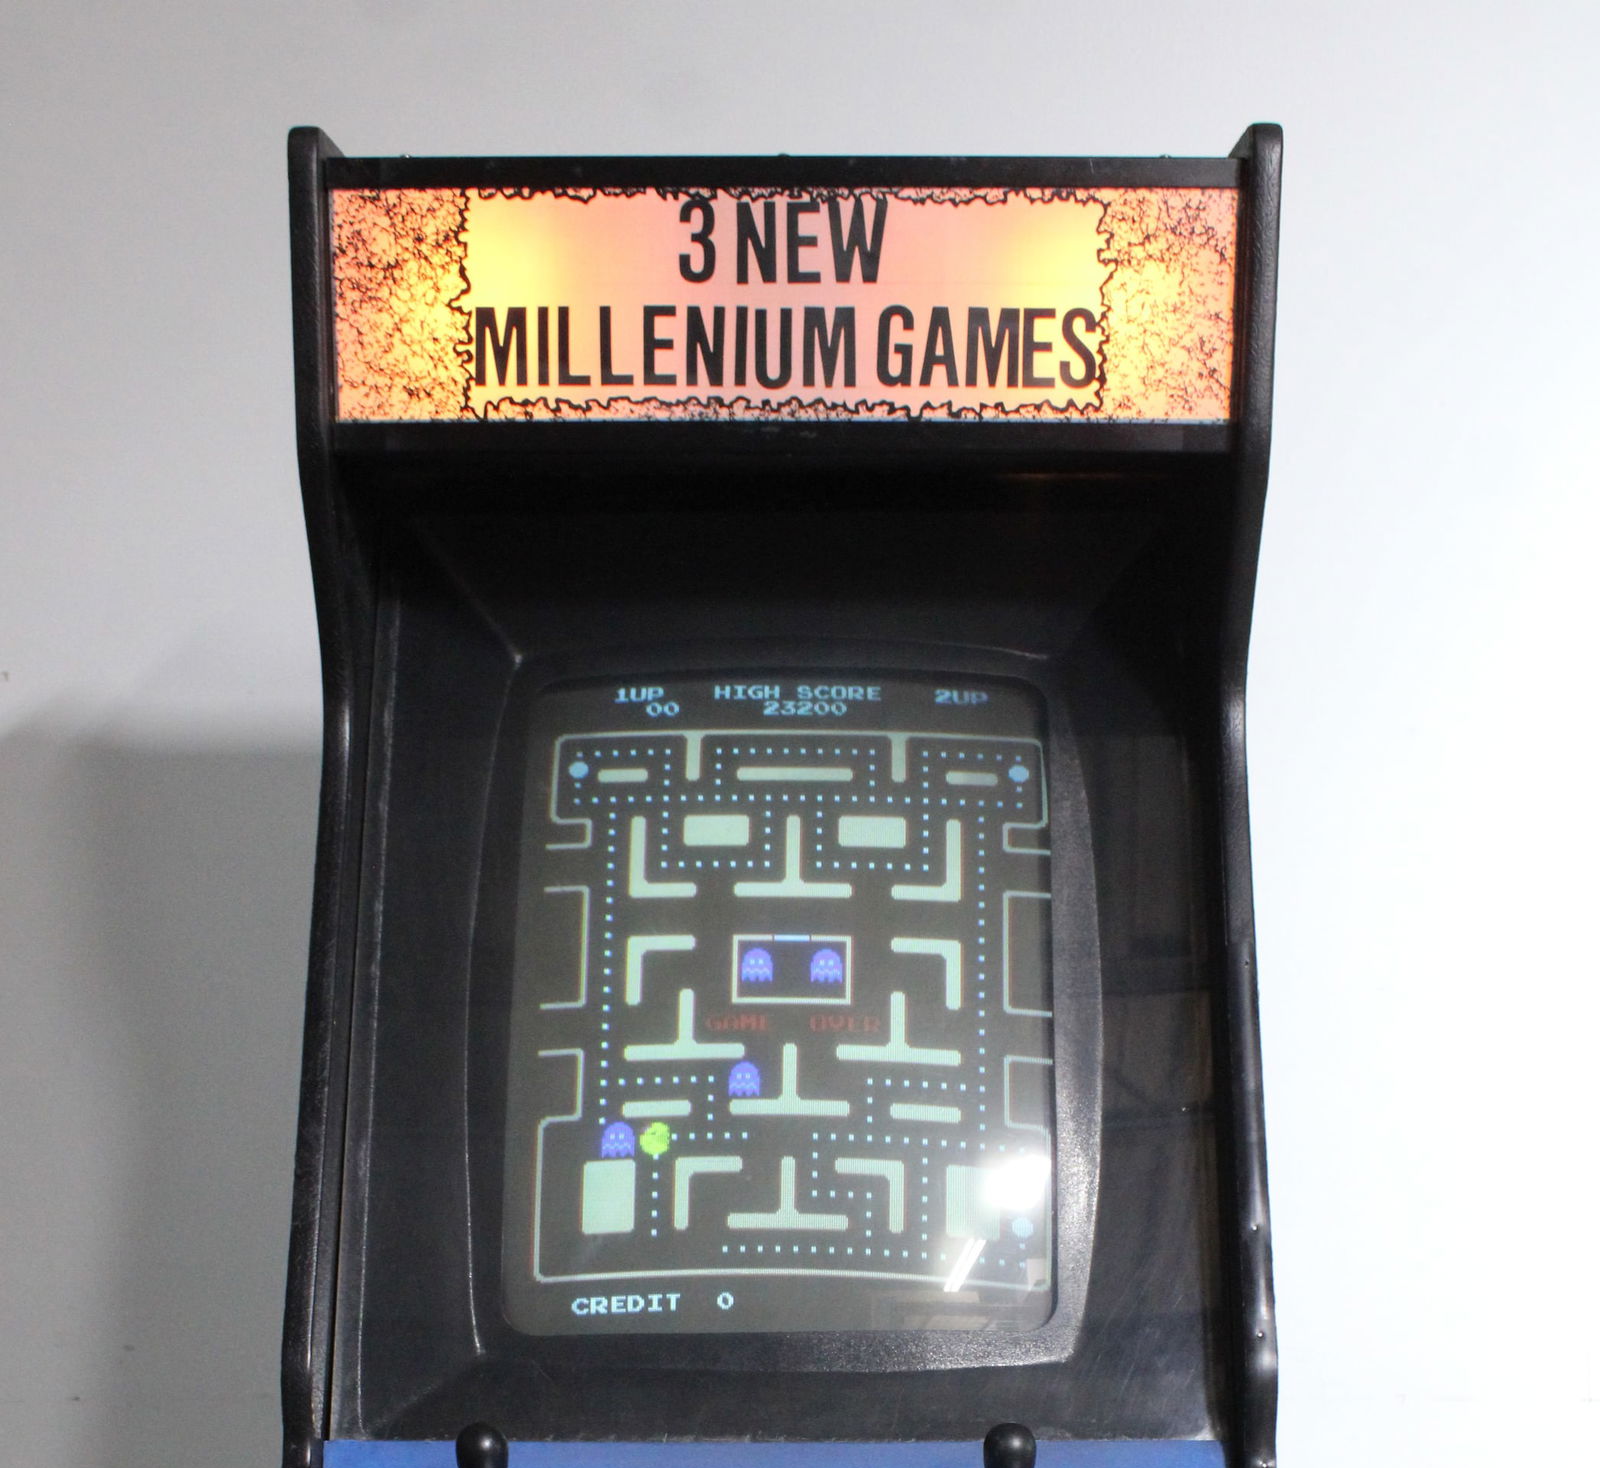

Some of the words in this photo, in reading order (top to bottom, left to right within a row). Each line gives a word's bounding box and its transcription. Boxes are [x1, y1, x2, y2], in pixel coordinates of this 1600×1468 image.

[678, 200, 717, 284] 3
[735, 199, 888, 285] NEW
[475, 305, 857, 390] MILLENIUM
[878, 306, 1097, 389] GAMES
[615, 687, 665, 703] 1UP
[713, 685, 780, 700] HIGH
[797, 685, 882, 701] SCORE
[933, 689, 989, 705] 2UP
[645, 702, 680, 717] 00
[763, 701, 848, 717] 23200
[706, 1014, 769, 1032] GAME
[810, 1014, 881, 1032] OVER
[571, 1293, 681, 1316] CREDIT
[716, 1291, 734, 1311] 0
